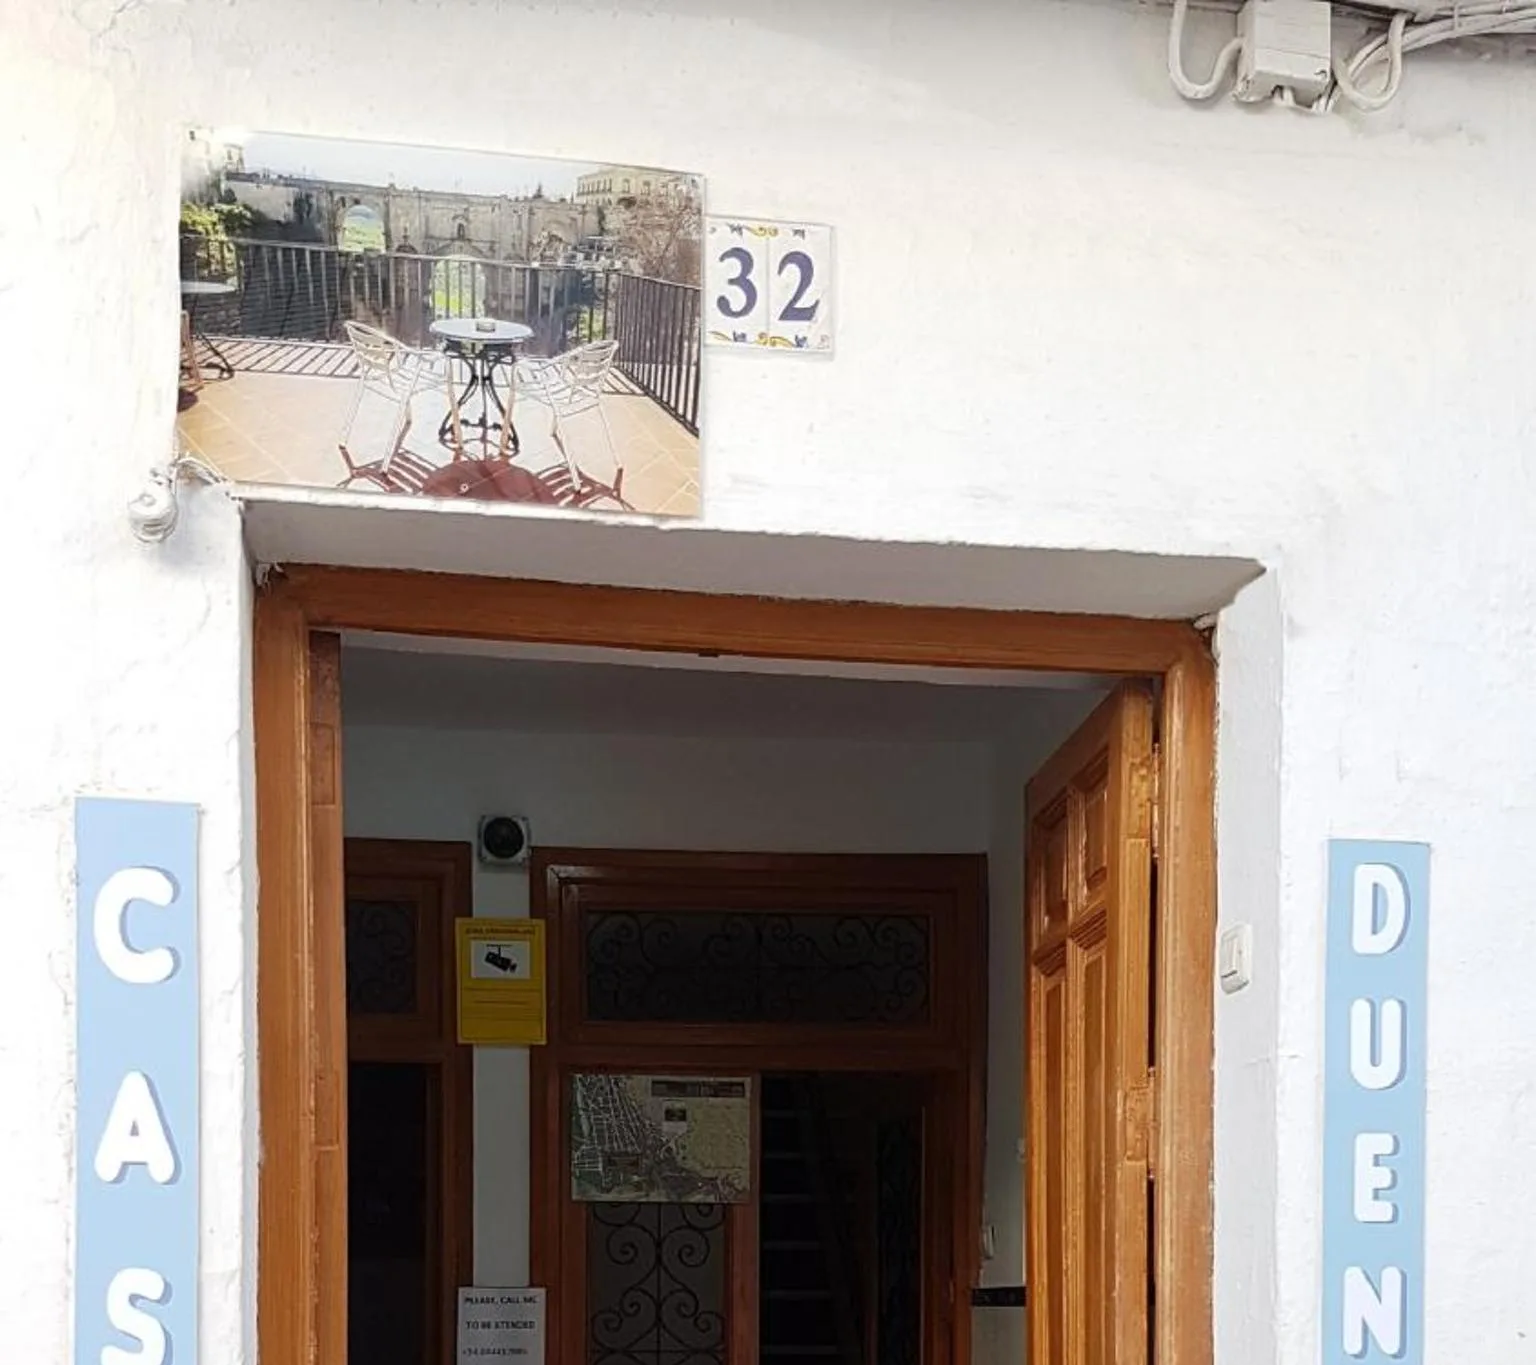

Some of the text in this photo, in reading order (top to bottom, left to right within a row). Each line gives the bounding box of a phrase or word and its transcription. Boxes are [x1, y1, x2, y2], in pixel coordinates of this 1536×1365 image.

[716, 247, 820, 321] 32
[500, 1296, 520, 1304] CALL
[465, 1320, 479, 1330] TO
[481, 1321, 491, 1330] BE
